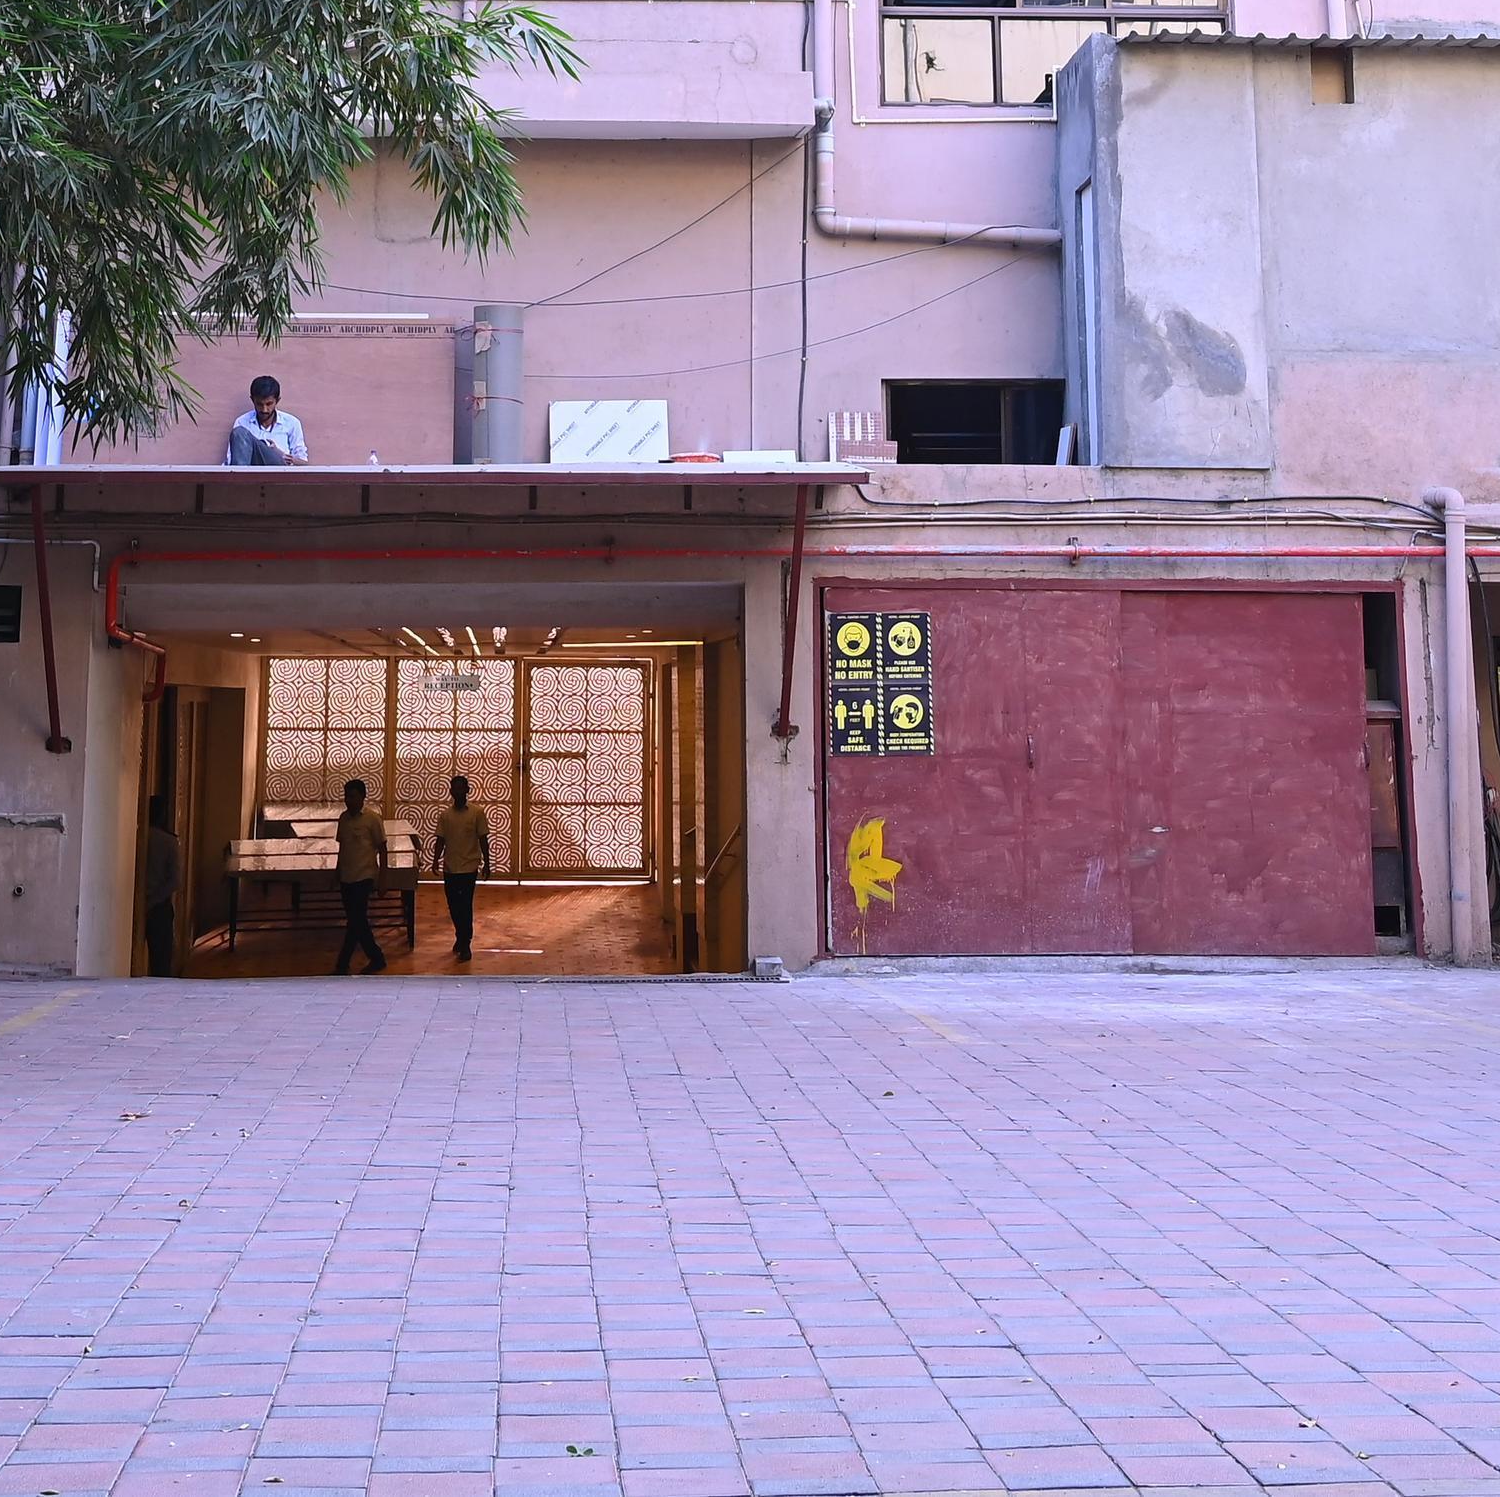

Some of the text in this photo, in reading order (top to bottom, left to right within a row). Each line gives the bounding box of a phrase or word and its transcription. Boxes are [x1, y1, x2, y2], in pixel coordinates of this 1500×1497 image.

[339, 325, 384, 333] ARCHIDPLY
[392, 326, 436, 334] ARCHIDPLY
[836, 659, 872, 668] NO MASK
[835, 671, 873, 679] NO ENTRY
[852, 701, 858, 709] 6
